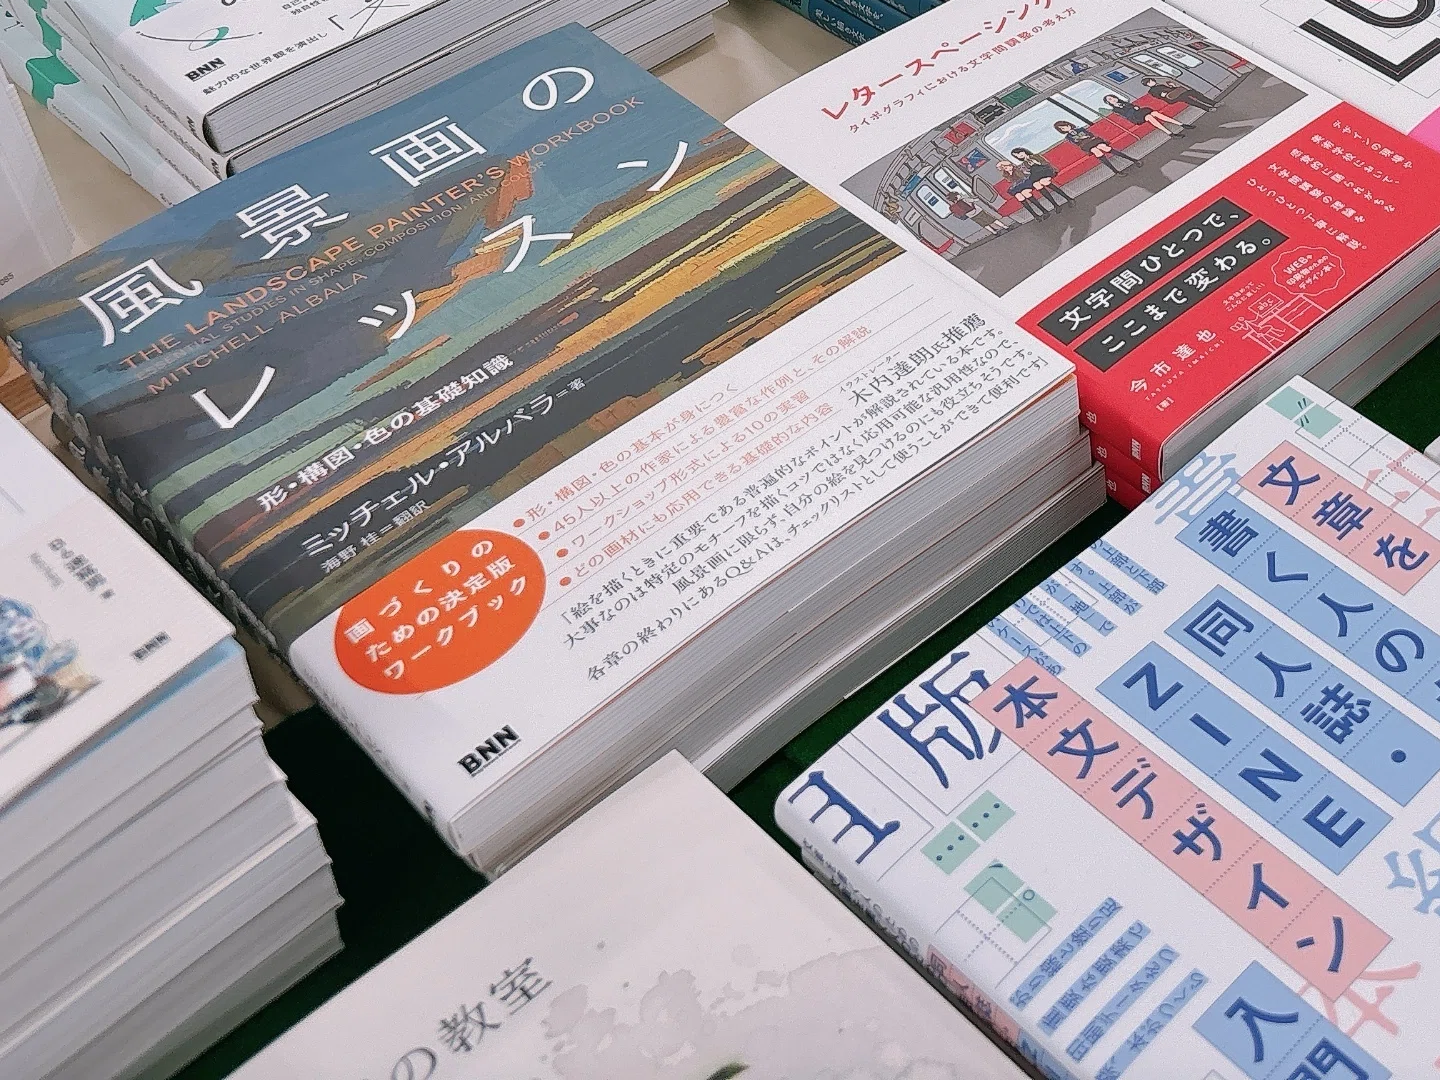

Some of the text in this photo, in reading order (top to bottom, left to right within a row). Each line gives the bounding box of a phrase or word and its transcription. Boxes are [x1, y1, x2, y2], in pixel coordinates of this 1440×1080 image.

[184, 58, 226, 82] BNN
[848, 5, 1077, 135] タイポグラフィにおける文字間調整の考え方
[1267, 162, 1366, 224] 文字間調整の理論を
[1289, 147, 1396, 214] 感覚的に語られがちな
[1310, 133, 1401, 184] 美術学校において、
[1332, 119, 1414, 170] デザインの現場や
[78, 66, 595, 348] 風景画の
[119, 331, 183, 369] THE
[186, 237, 364, 337] LANDSCAPE
[507, 94, 645, 170] WORKBOOK
[1246, 177, 1368, 251] ひとつひとつ丁寧に解説。
[191, 139, 690, 430] レッスン
[1058, 211, 1240, 331] 文字間ひとつで、
[1101, 237, 1273, 354] ここまで変わる。
[145, 269, 369, 397] MITCHELL ALBALA
[849, 312, 987, 408] 木内達朗氏推薦
[1129, 328, 1217, 394] 今市達也
[1144, 339, 1225, 401] TATSUYA IMAICHI
[255, 352, 514, 513] 形・構図・色の基礎知識
[524, 383, 739, 522] 形・構図・色の基本が身につく
[553, 325, 872, 533] 45人以上の作家による豊富な作例と、その解説
[571, 388, 811, 548] ワークショップ形式による10の実習
[671, 349, 1034, 595] 風景画に限らず、自分の絵を見つけるのにも役立ちそうです。
[563, 338, 1020, 650] 大事なのは特定のモチーフを描くコツではなく応用可能な汎用性なので、
[574, 402, 834, 578] どの画材にも応用できる基礎的な内容
[1258, 454, 1431, 572] 文章を
[320, 546, 361, 576] 海野
[343, 535, 497, 644] 画づくりの
[363, 556, 517, 662] ための決定版
[382, 575, 530, 682] ワークブック
[457, 724, 521, 776] BNN
[1123, 660, 1367, 846] ZINE
[992, 673, 1347, 974] 本文デザイン
